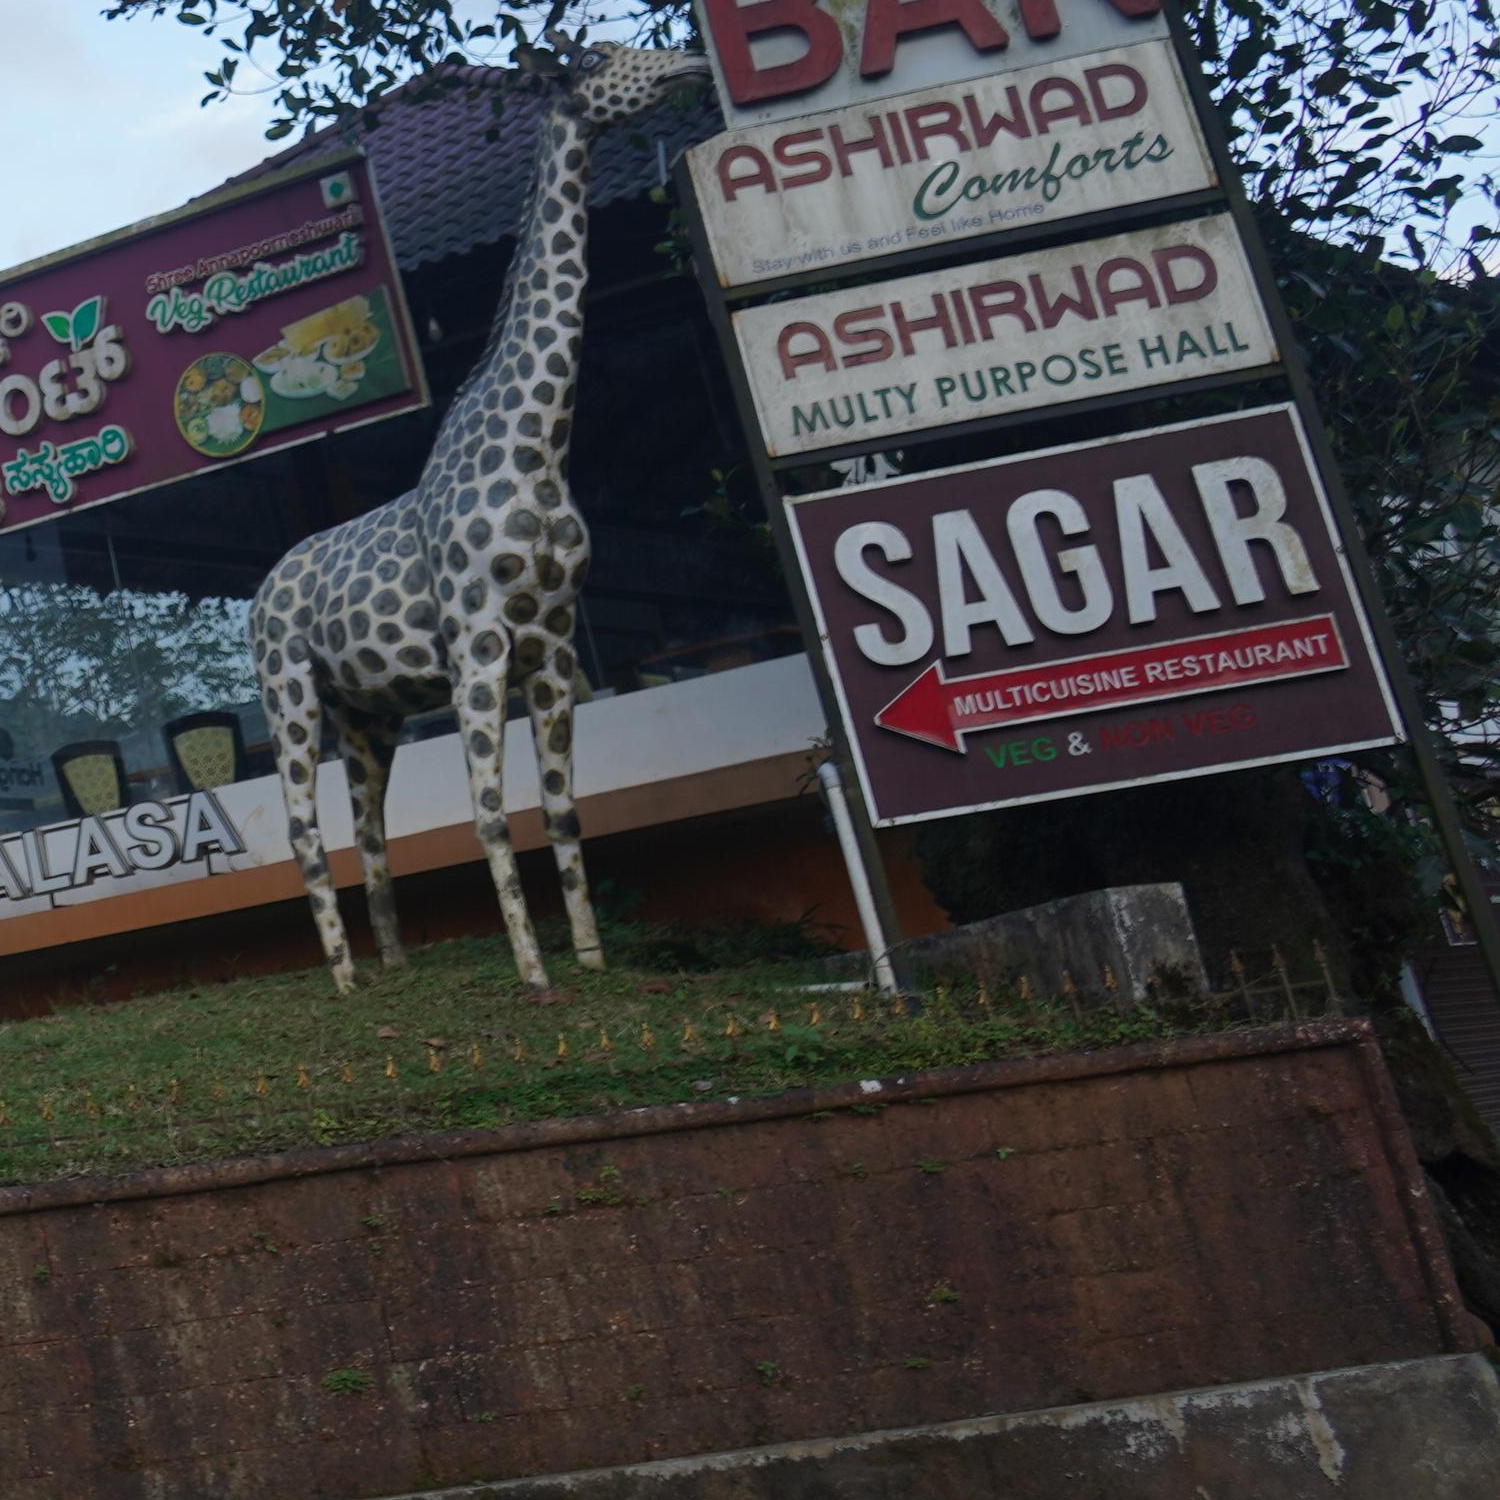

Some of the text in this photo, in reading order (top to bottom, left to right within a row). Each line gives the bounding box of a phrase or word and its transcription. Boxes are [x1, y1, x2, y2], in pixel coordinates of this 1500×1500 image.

[717, 62, 1148, 201] ASHIRWAD
[912, 130, 1174, 221] Comforts
[146, 265, 194, 293] Shree
[148, 234, 362, 334] Veg Restaurant
[752, 202, 1046, 275] Stay with us and Feel like Home
[775, 245, 1218, 381] ASHIRWAD
[792, 321, 1250, 437] MULTY PURPOSE HALL
[833, 455, 1320, 667] SAGAR
[954, 634, 1331, 717] MULTICUISINE RESTAURANT
[985, 702, 1257, 770] VEG & NON VEG
